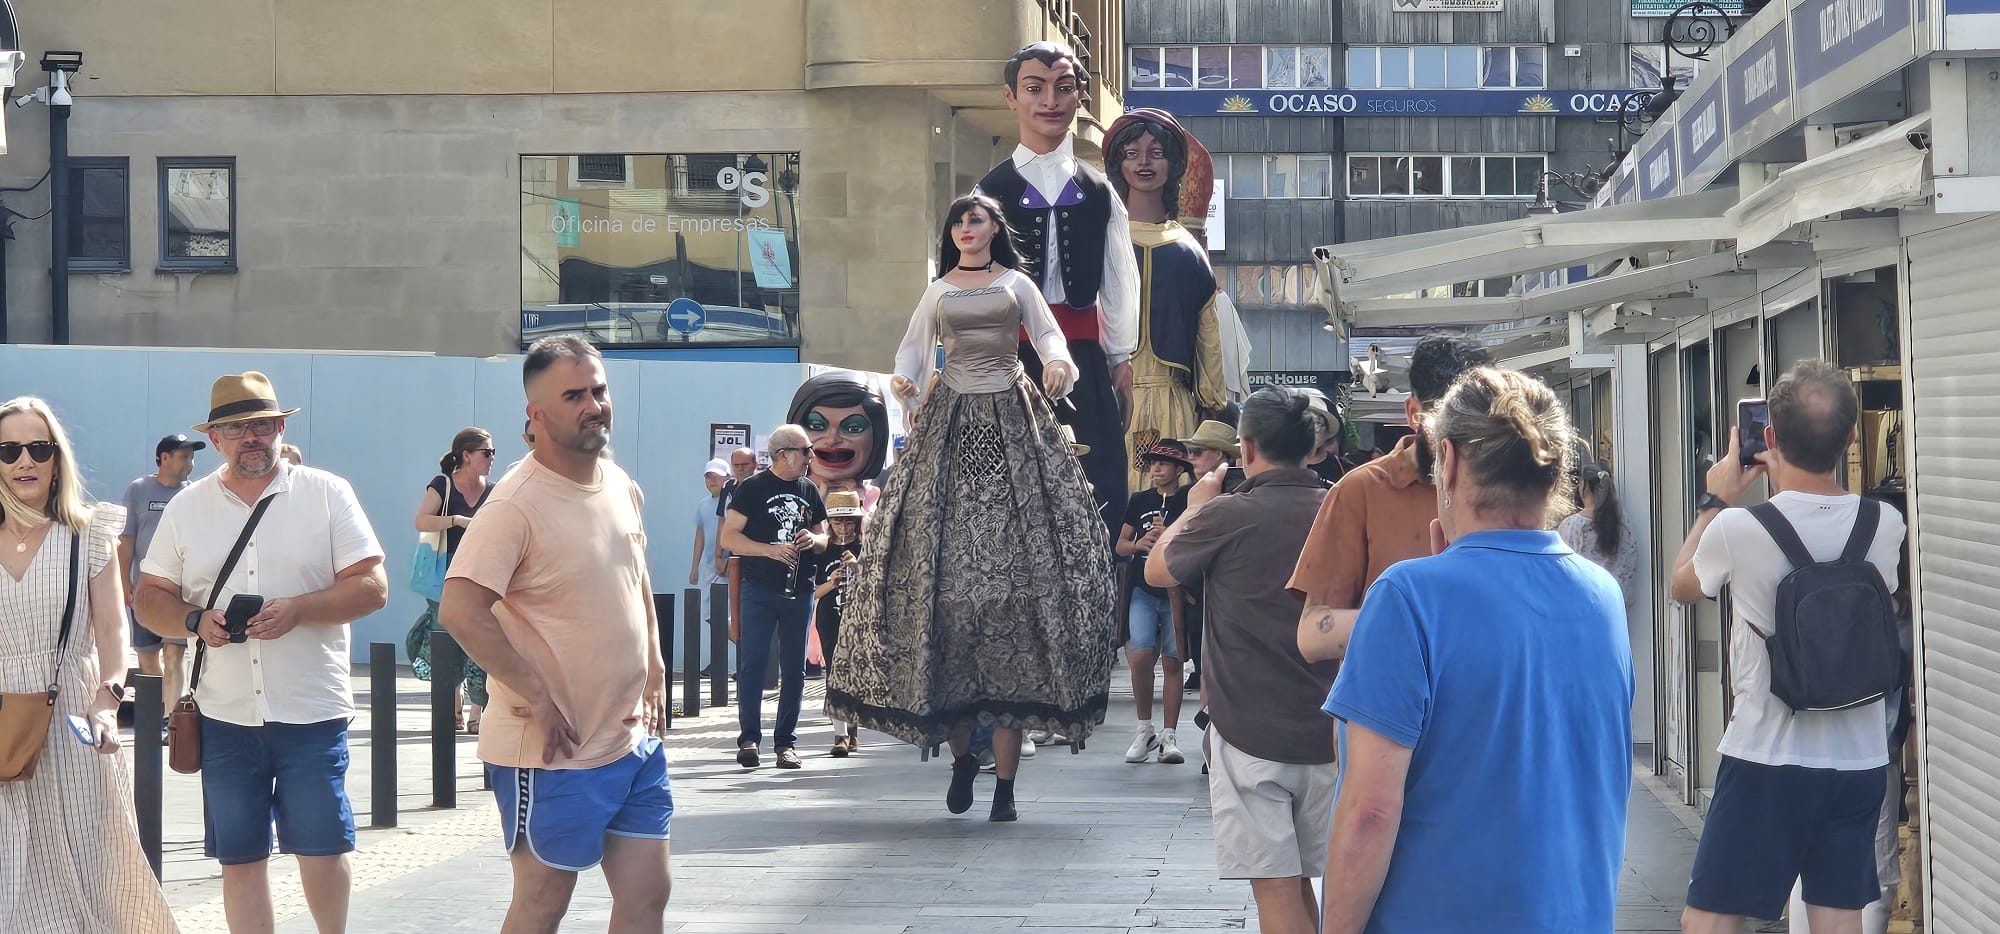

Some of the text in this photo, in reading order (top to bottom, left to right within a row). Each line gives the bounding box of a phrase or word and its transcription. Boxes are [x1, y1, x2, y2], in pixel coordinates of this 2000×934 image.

[1269, 94, 1437, 113] OCASO SEGUROS
[1570, 93, 1645, 112] OCAS
[551, 214, 770, 236] Oficina de Empresas
[1275, 373, 1318, 385] House
[718, 437, 743, 445] JOL
